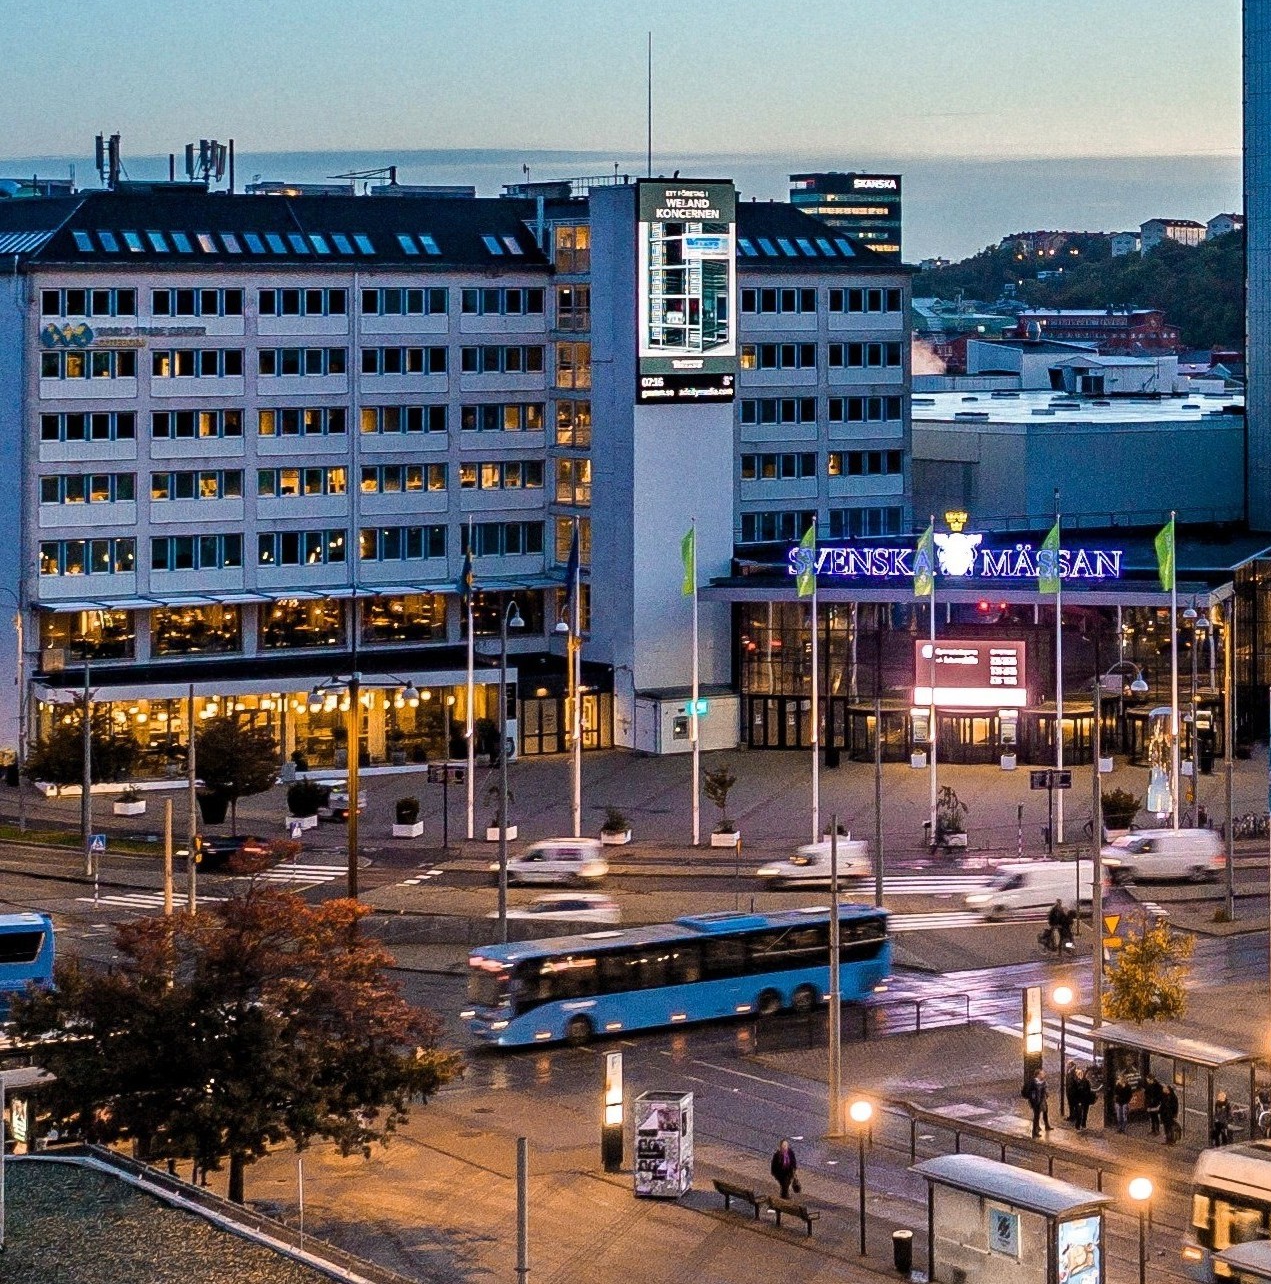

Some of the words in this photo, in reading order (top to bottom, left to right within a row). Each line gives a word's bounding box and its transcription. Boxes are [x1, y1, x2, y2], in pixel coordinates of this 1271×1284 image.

[853, 178, 897, 190] SKANSKA
[666, 198, 710, 209] WELAND
[655, 208, 720, 219] KONCERNEN
[788, 546, 936, 577] SVENSKA
[981, 543, 1123, 578] MÄSSAN
